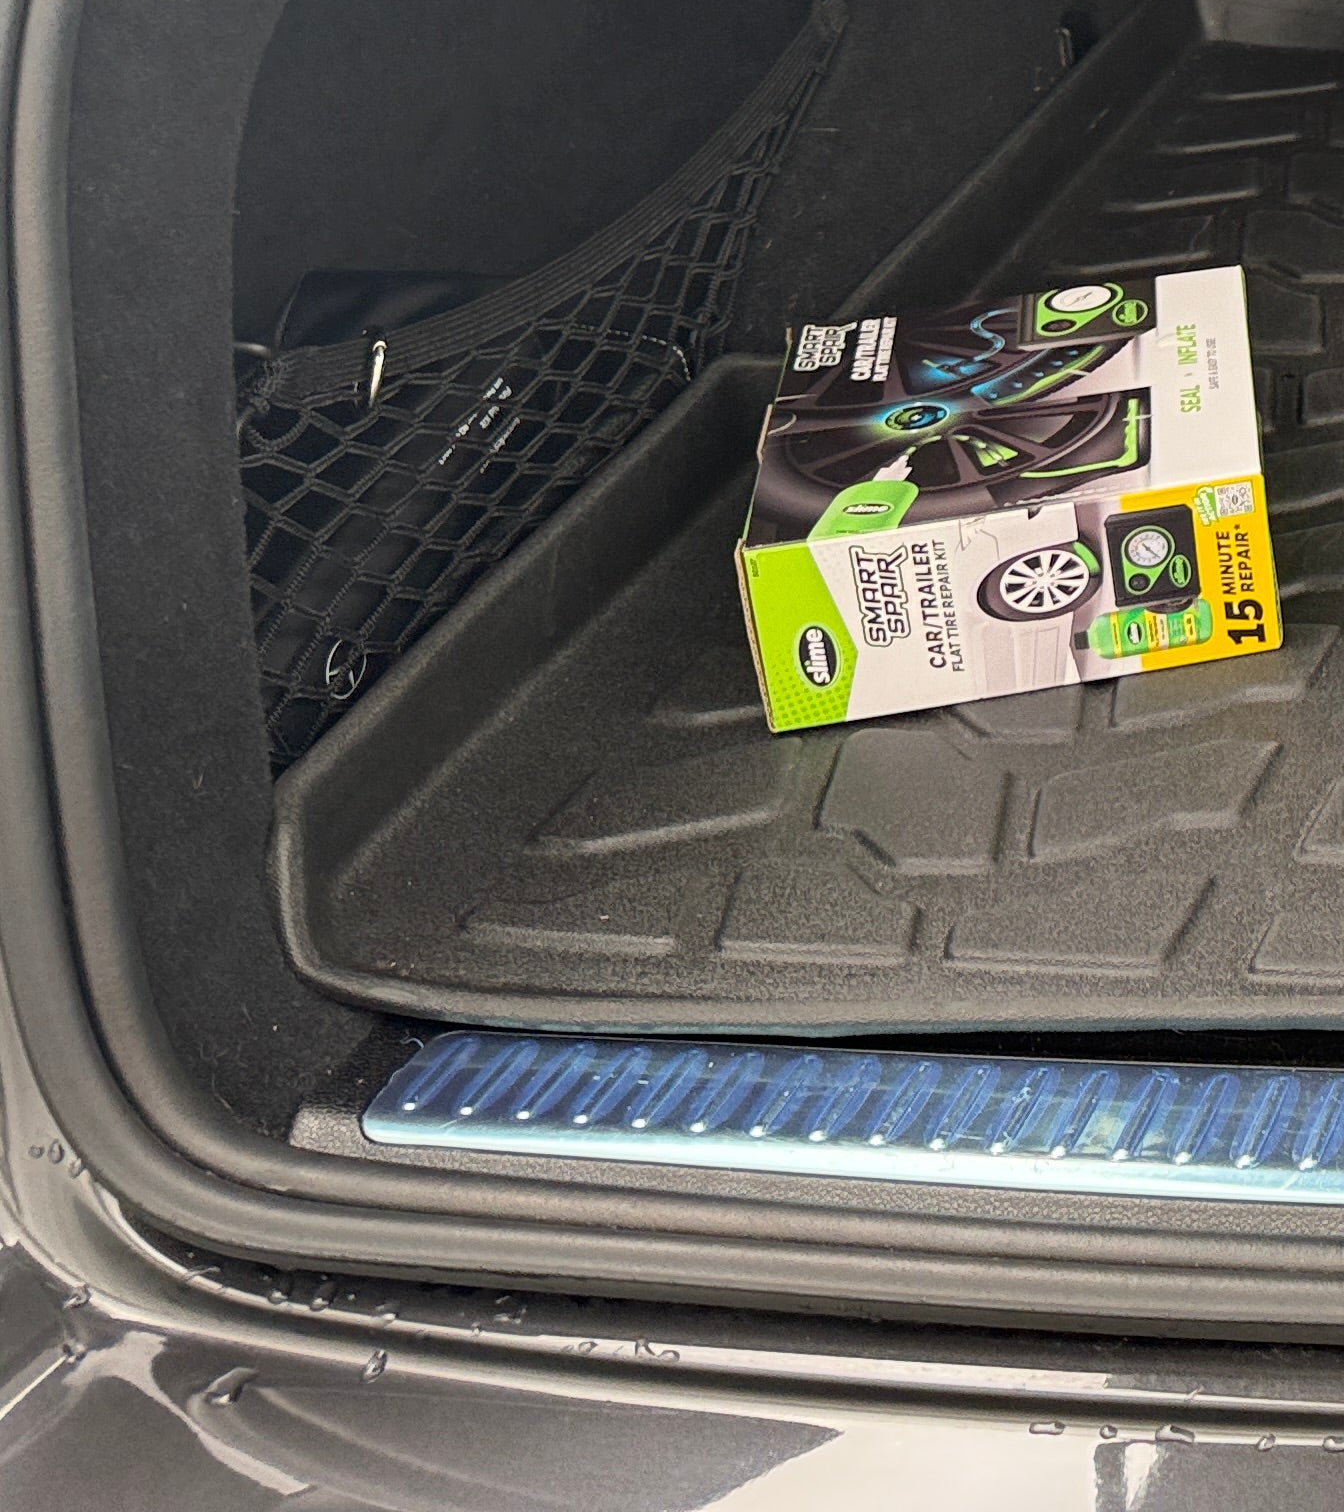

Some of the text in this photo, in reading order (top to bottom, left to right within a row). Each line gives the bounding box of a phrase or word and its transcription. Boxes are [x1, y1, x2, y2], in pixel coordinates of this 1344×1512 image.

[798, 327, 824, 369] SMART
[1175, 323, 1202, 413] SEAL INFLATE
[855, 551, 887, 643] SMART
[876, 552, 906, 634] SPAIR
[1216, 531, 1236, 595] MINUTE
[911, 542, 947, 669] CAR/TRAILER
[932, 539, 965, 672] FLAT TIRE REPAIR KIT
[1223, 599, 1267, 645] 15
[803, 628, 831, 684] slime
